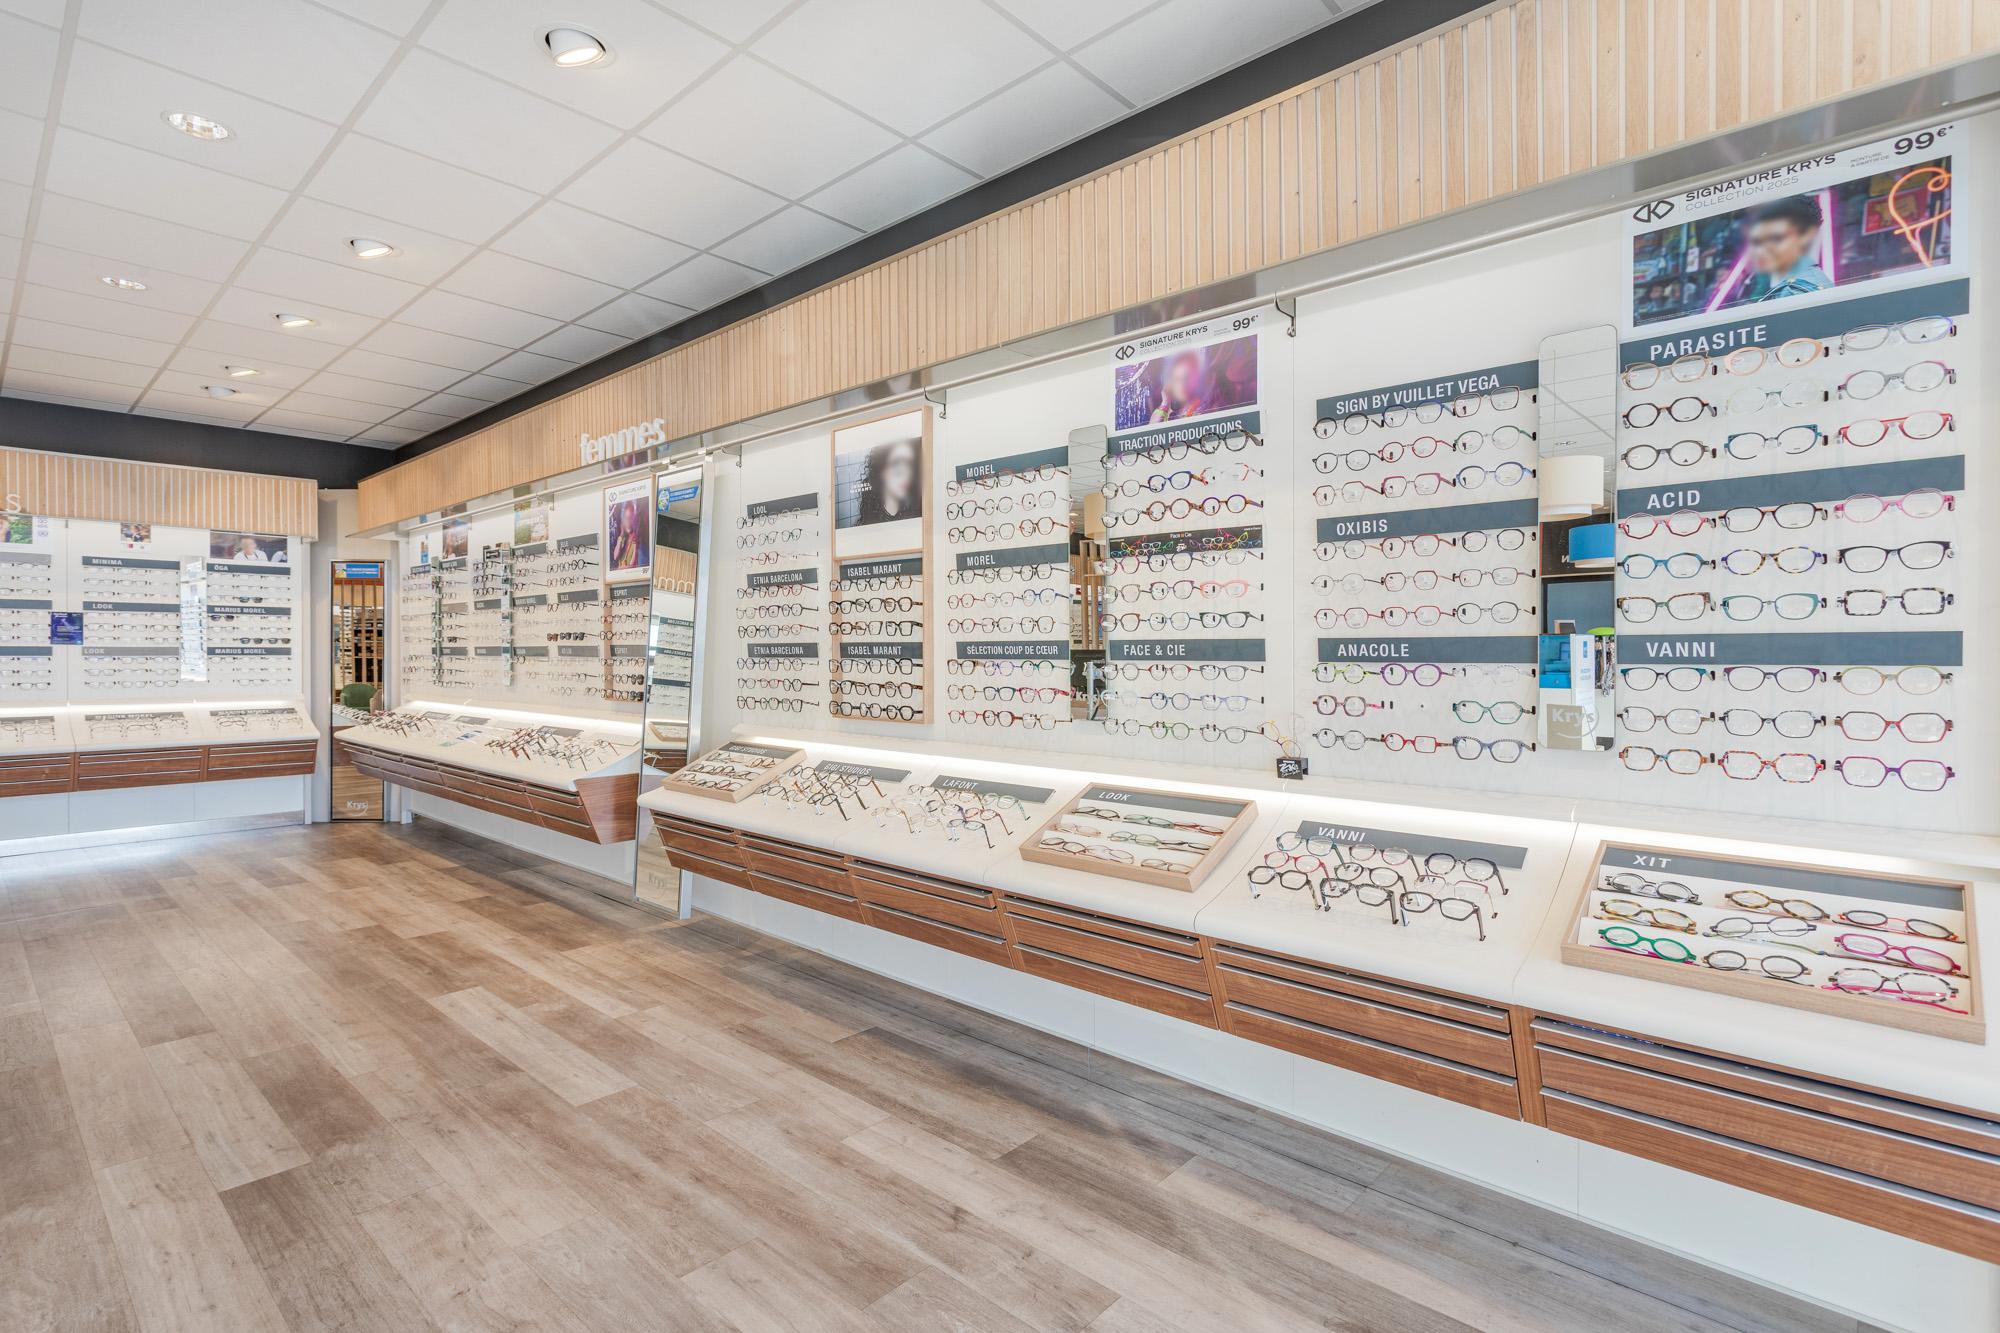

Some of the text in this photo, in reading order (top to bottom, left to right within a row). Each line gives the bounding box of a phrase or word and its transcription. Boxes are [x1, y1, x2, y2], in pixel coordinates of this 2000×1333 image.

[1685, 154, 1836, 202] SIGNATURE KRYS
[1685, 176, 1799, 211] COLLECTION 2025
[1139, 332, 1184, 349] SIGNATURE
[1185, 325, 1208, 337] KRYS
[1650, 324, 1767, 361] PARASITE
[1336, 374, 1500, 415] SIGN BY VUILLET VEGA
[1118, 420, 1243, 452] TRACTION PRODUCTIONS
[966, 464, 996, 478] MOREL
[1647, 490, 1700, 510] ACID
[1336, 519, 1388, 536] OXIBIS
[966, 555, 996, 567] MOREL
[847, 564, 902, 577] ISABEL MARANT
[753, 573, 803, 585] ETNIA BARCELONA
[753, 646, 804, 655] ETNIA BARCELONA
[847, 646, 902, 655] ISABEL MARANT
[966, 644, 1059, 655] SÉLECTION COUP DE CŒUR
[1123, 644, 1186, 656] FACE & CIE
[1337, 643, 1410, 657] ANACOLE
[1646, 641, 1715, 658] VANNI
[1552, 708, 1595, 727] Krys
[840, 765, 871, 776] STUDIOS
[943, 779, 978, 791] LAFONT
[1098, 791, 1131, 802] LOOK
[1318, 827, 1366, 842] VANNI
[1633, 854, 1672, 869] XIT
